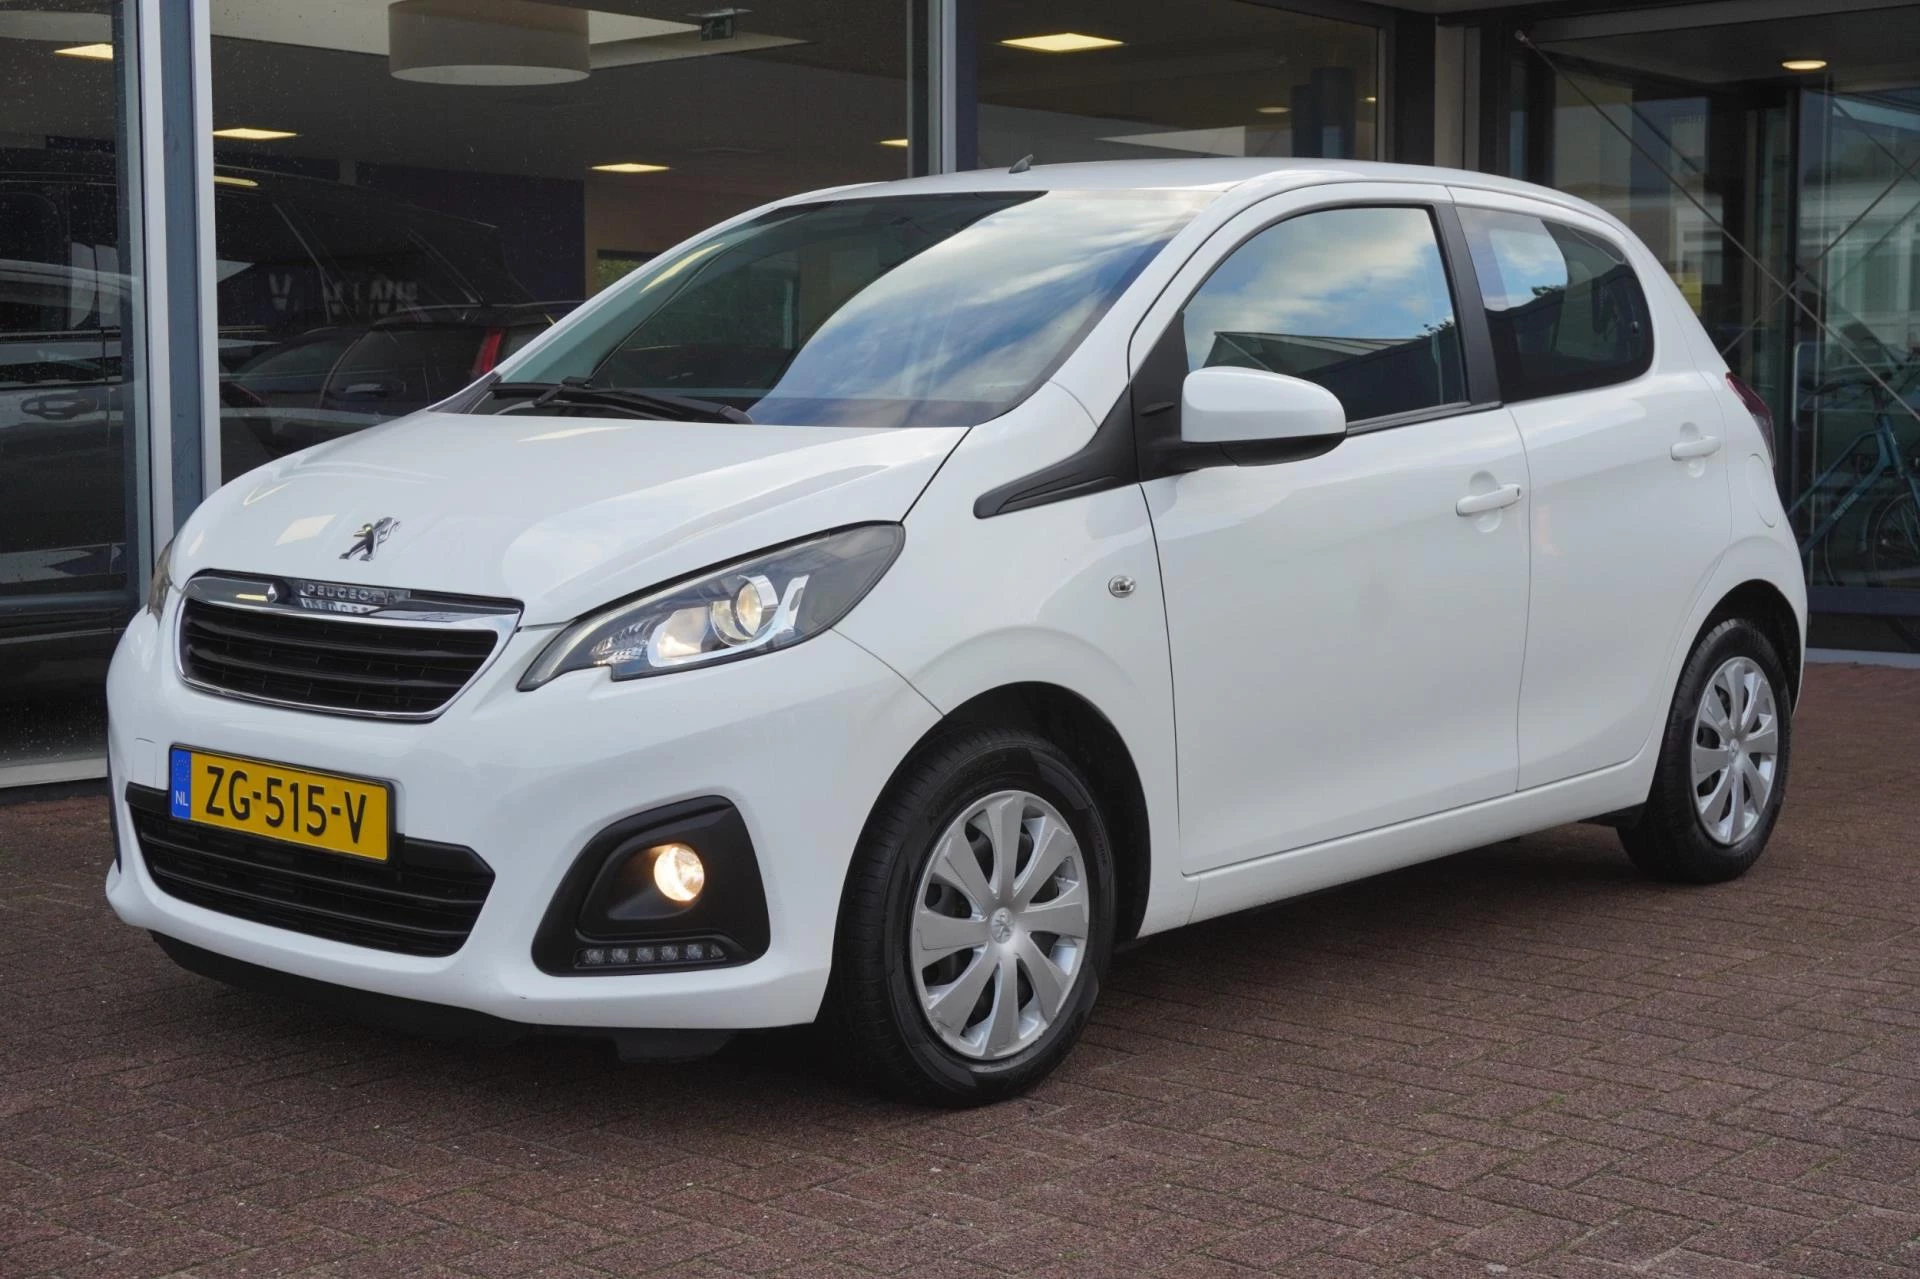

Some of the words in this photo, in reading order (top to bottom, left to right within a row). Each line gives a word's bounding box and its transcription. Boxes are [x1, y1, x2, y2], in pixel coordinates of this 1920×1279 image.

[306, 583, 379, 604] PEUGEOT
[175, 790, 189, 807] NL
[205, 765, 368, 845] ZG-515-V
